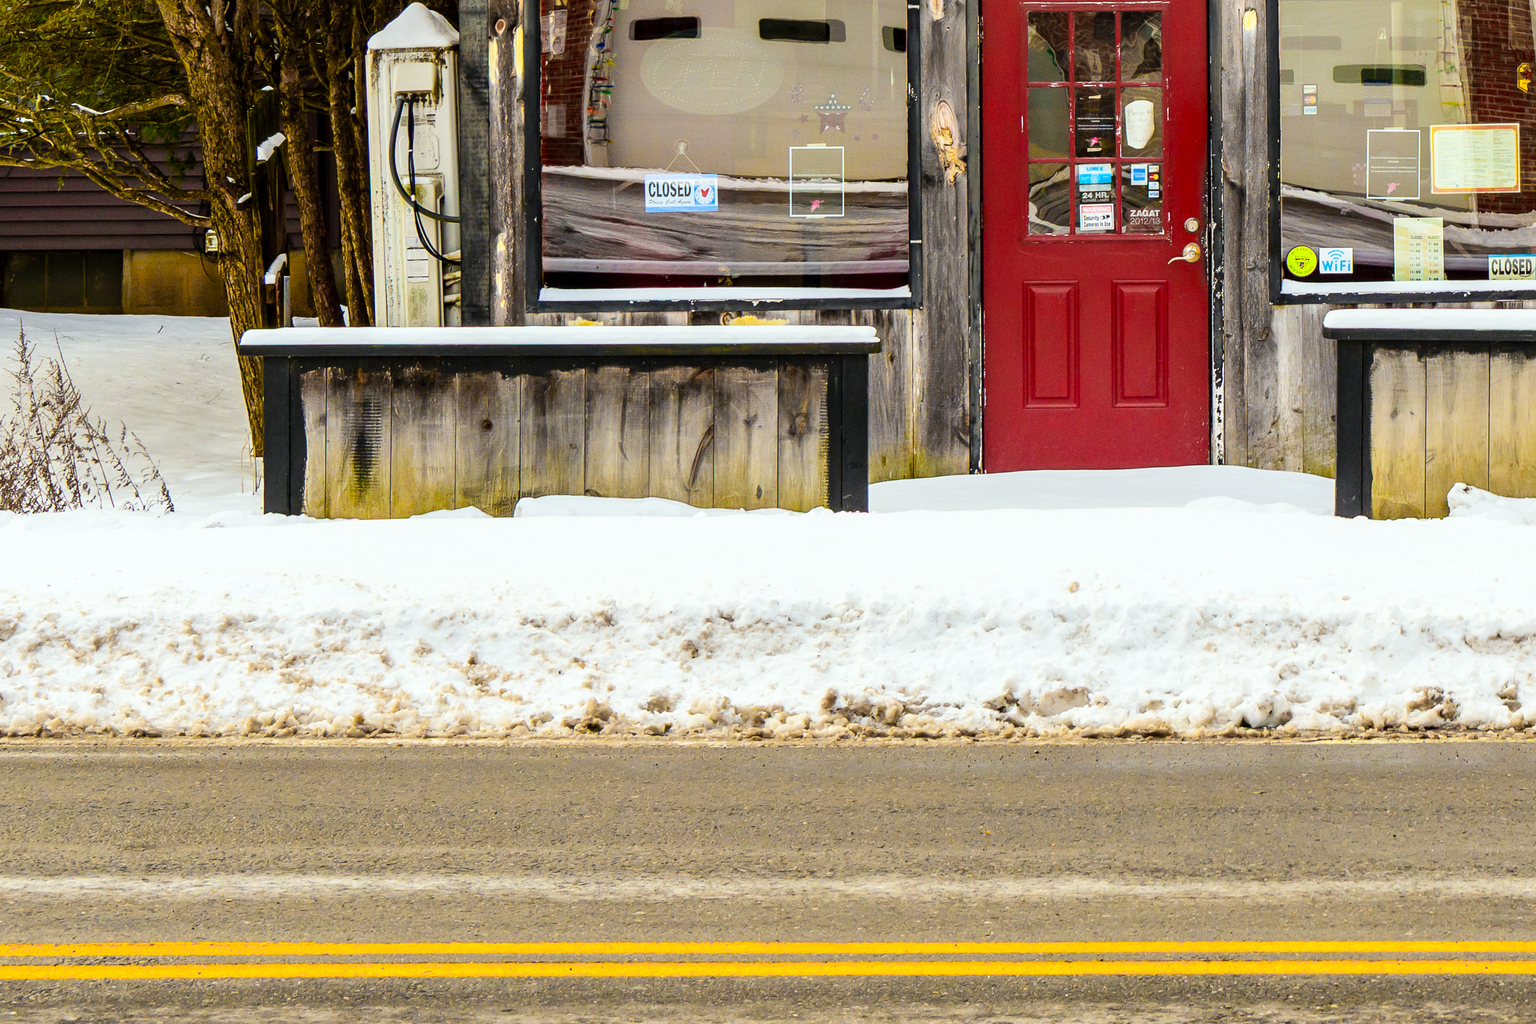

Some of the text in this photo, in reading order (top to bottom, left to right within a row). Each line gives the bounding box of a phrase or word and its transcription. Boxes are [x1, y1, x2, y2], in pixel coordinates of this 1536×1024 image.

[653, 53, 768, 90] OPEN
[648, 181, 692, 198] CLOSED
[1095, 191, 1110, 199] HR.
[1129, 209, 1161, 217] ZAGAT
[1129, 217, 1161, 225] 2012/13
[1321, 259, 1351, 272] WiFi
[1491, 258, 1533, 276] CLOSED
